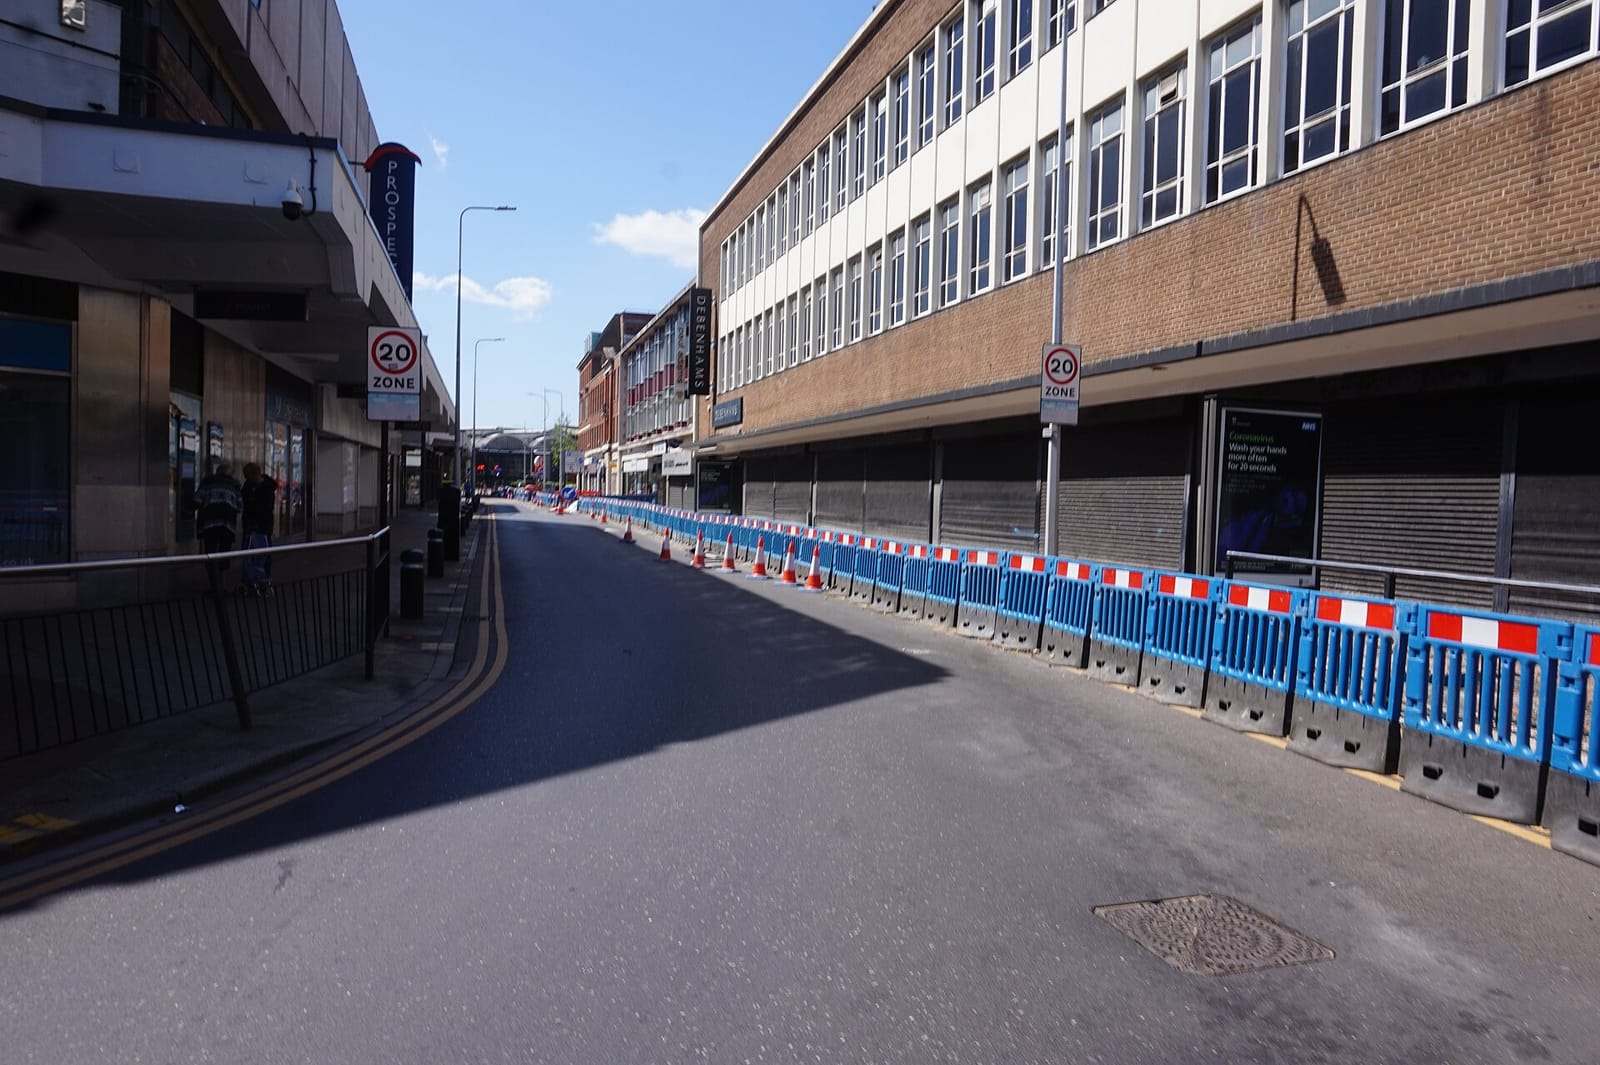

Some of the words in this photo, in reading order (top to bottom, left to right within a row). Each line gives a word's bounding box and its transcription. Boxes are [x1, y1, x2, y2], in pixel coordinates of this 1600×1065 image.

[694, 295, 706, 389] DEBENHAMS
[379, 343, 411, 362] 20
[1051, 358, 1073, 374] 20
[373, 376, 415, 389] ZONE
[1046, 386, 1075, 398] ZONE
[1302, 422, 1316, 432] NHS
[1229, 432, 1274, 443] Coronavirus
[1229, 443, 1248, 452] Wash
[1249, 446, 1265, 454] your
[1267, 445, 1287, 455] hands
[1228, 453, 1246, 461] more
[1248, 454, 1267, 463] often
[1228, 461, 1238, 470] for
[1240, 463, 1248, 472] 20
[1249, 463, 1277, 473] seconds
